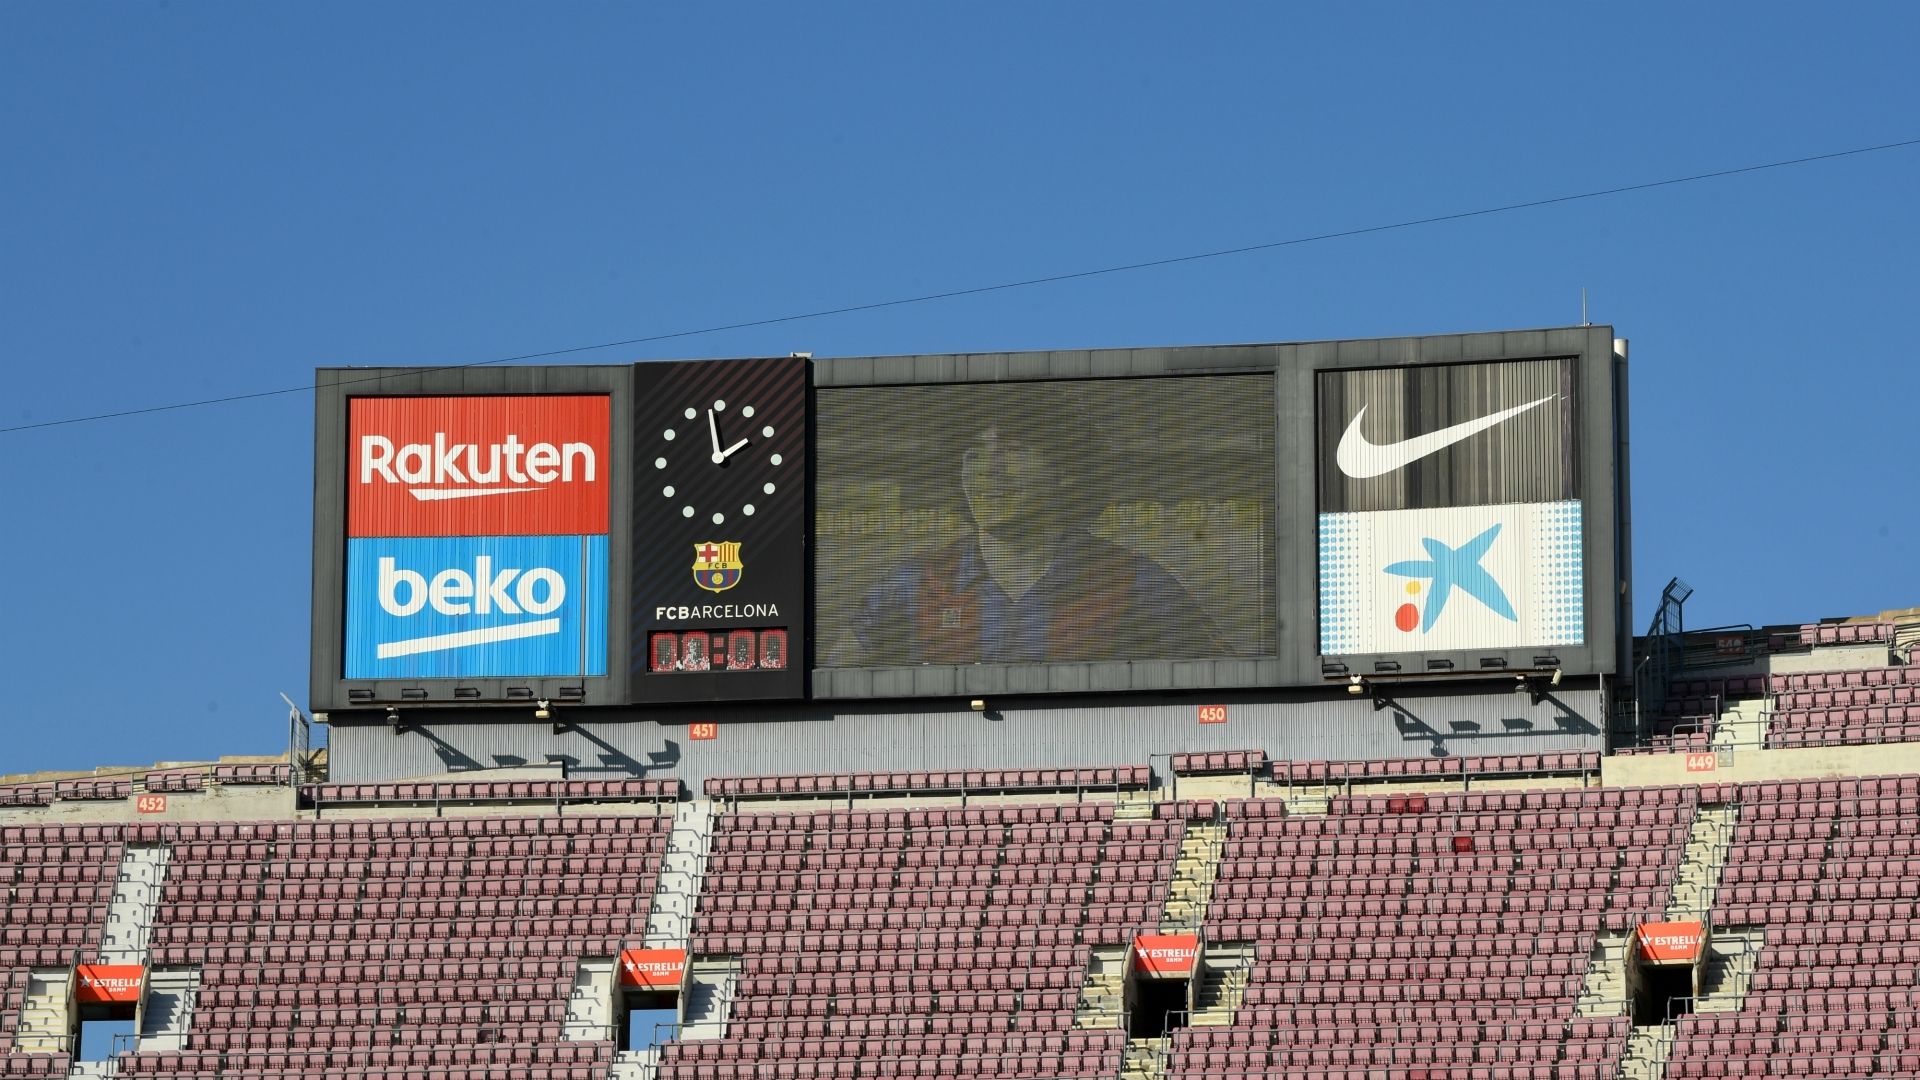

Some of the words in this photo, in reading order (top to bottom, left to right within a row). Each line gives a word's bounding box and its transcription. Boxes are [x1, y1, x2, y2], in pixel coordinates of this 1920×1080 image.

[361, 432, 596, 484] Rakuten
[378, 555, 566, 617] beko
[656, 603, 779, 620] FCBARCELONA
[1200, 707, 1225, 721] 450
[692, 723, 714, 737] 451
[1688, 755, 1714, 770] 449
[139, 797, 164, 811] 452
[637, 962, 683, 972] ESTRELLA
